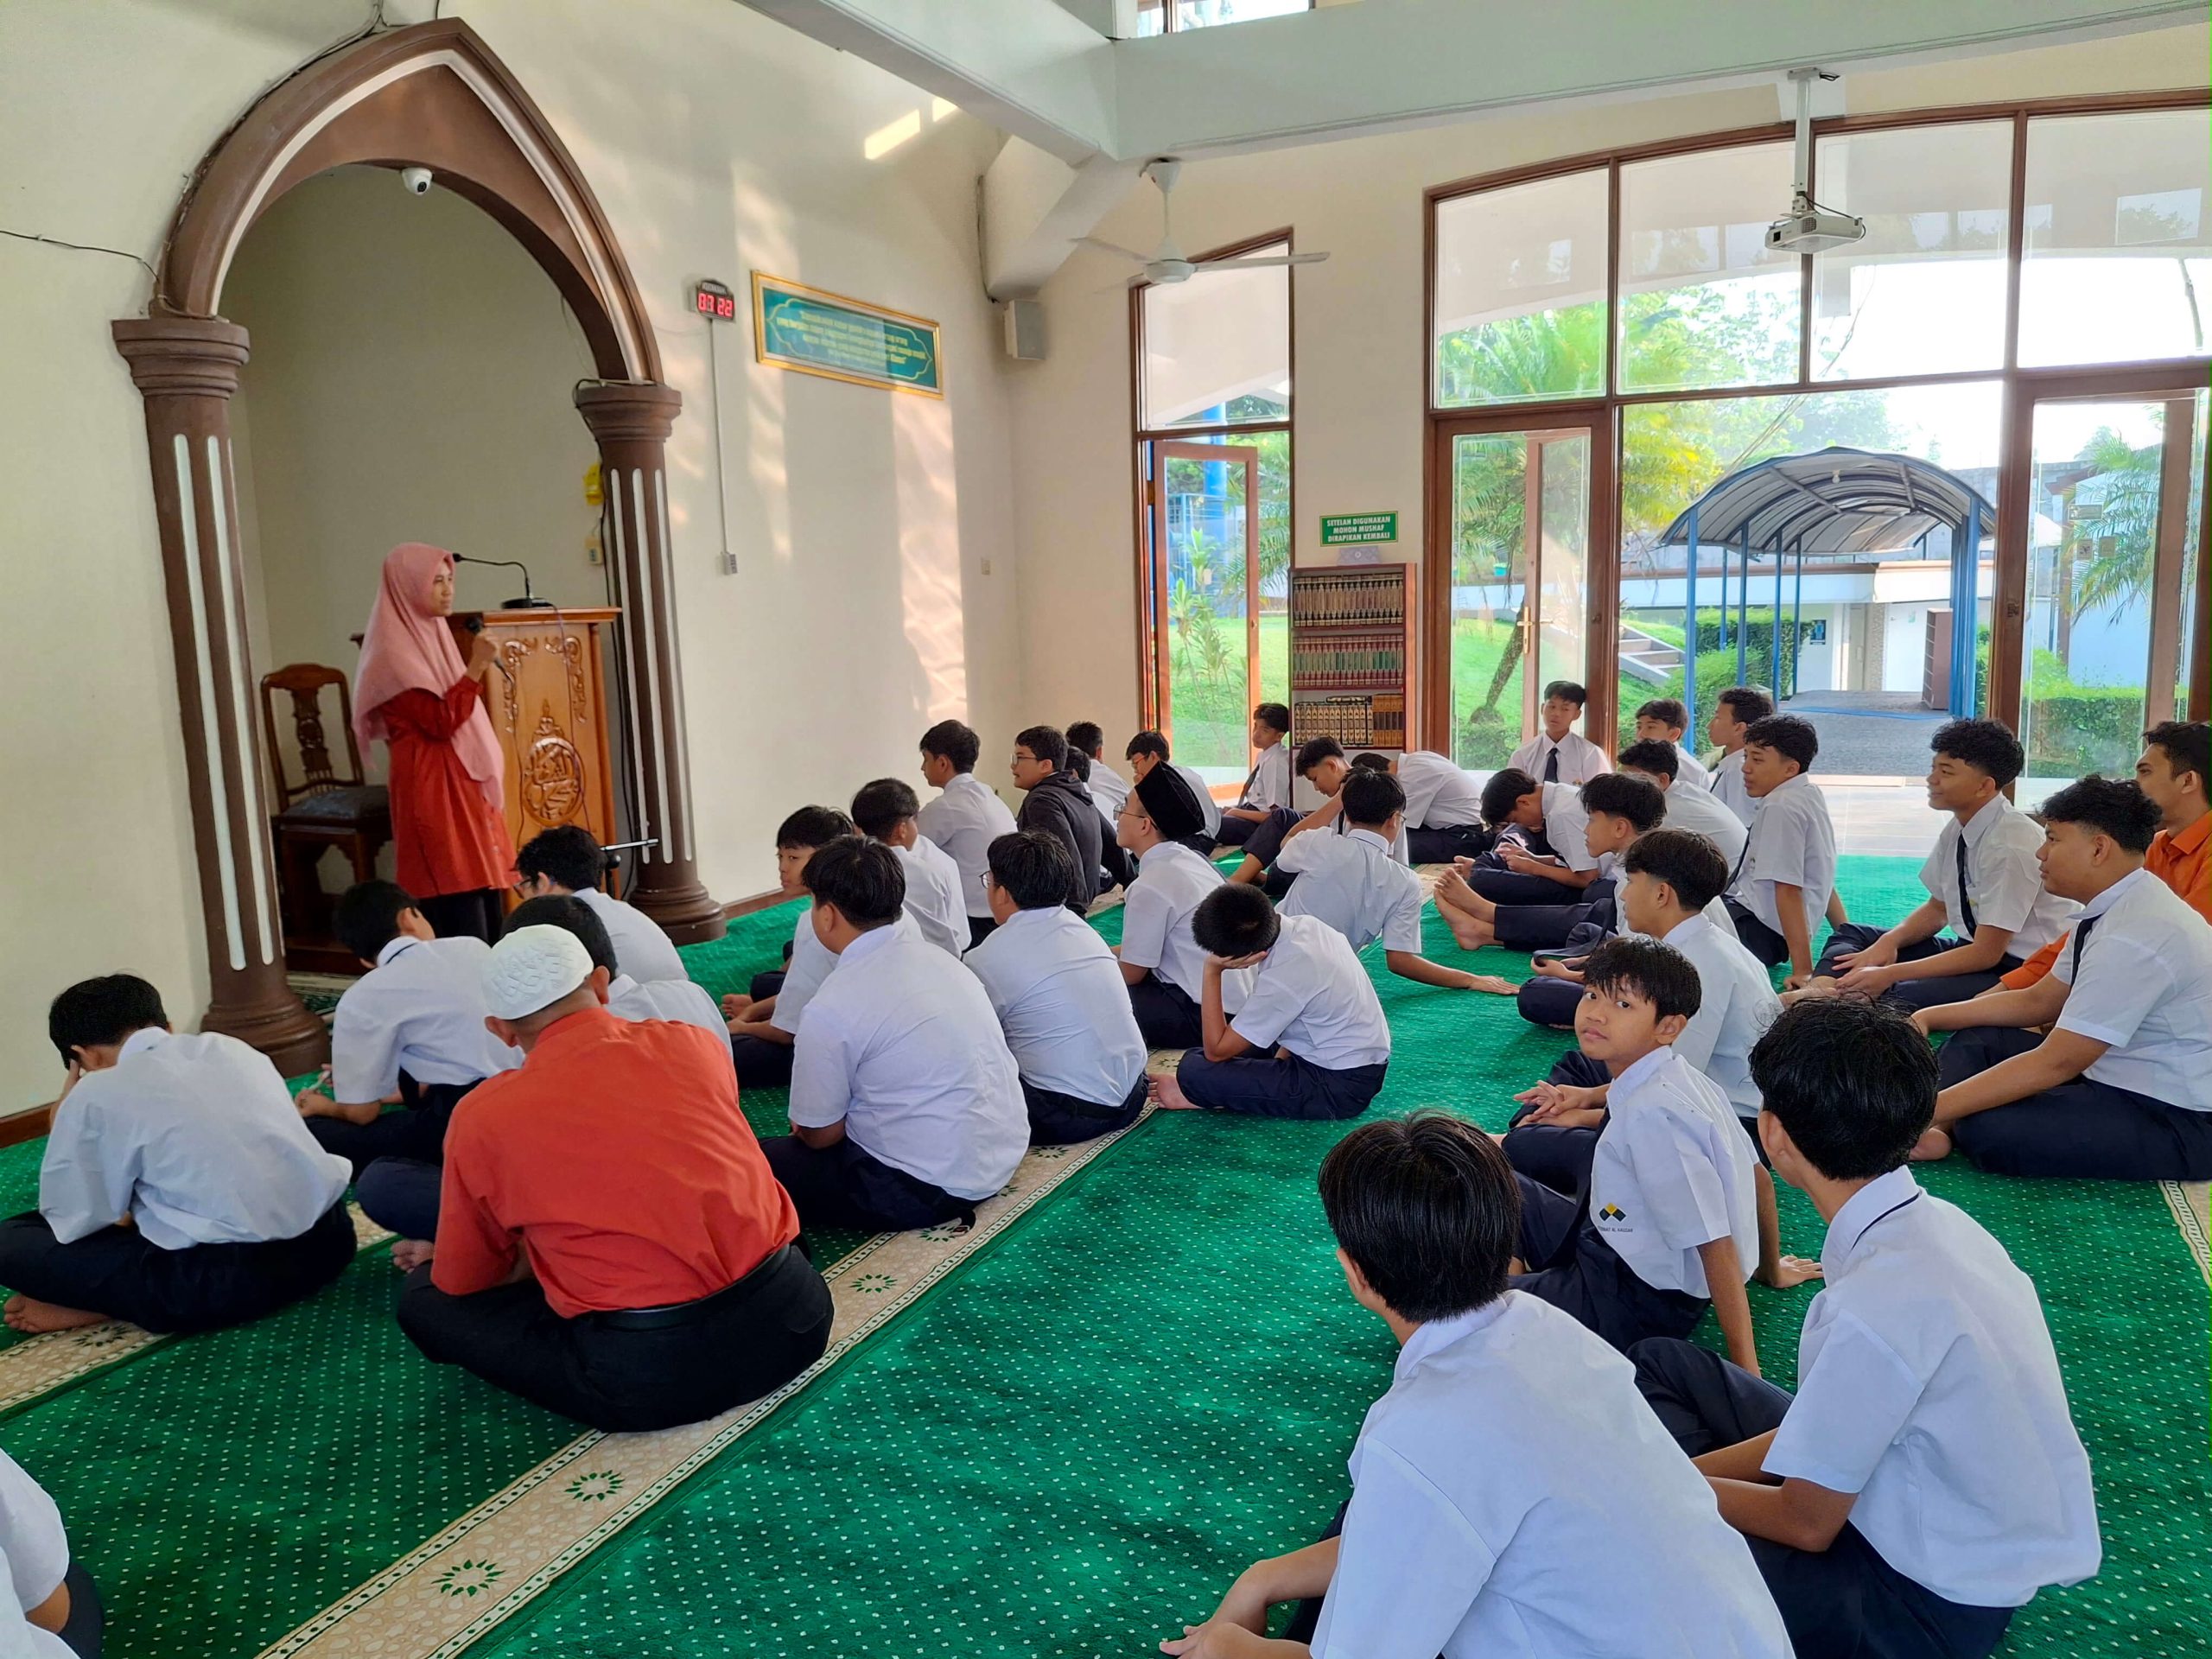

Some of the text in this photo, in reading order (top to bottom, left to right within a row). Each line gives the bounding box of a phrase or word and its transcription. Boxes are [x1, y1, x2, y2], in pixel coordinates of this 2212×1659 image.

[1326, 516, 1391, 527] SETELAH DIGUNAKAN
[1332, 524, 1385, 534] MOHON MUSHAF
[1327, 531, 1390, 543] DIRAPIKAN KEMBALI
